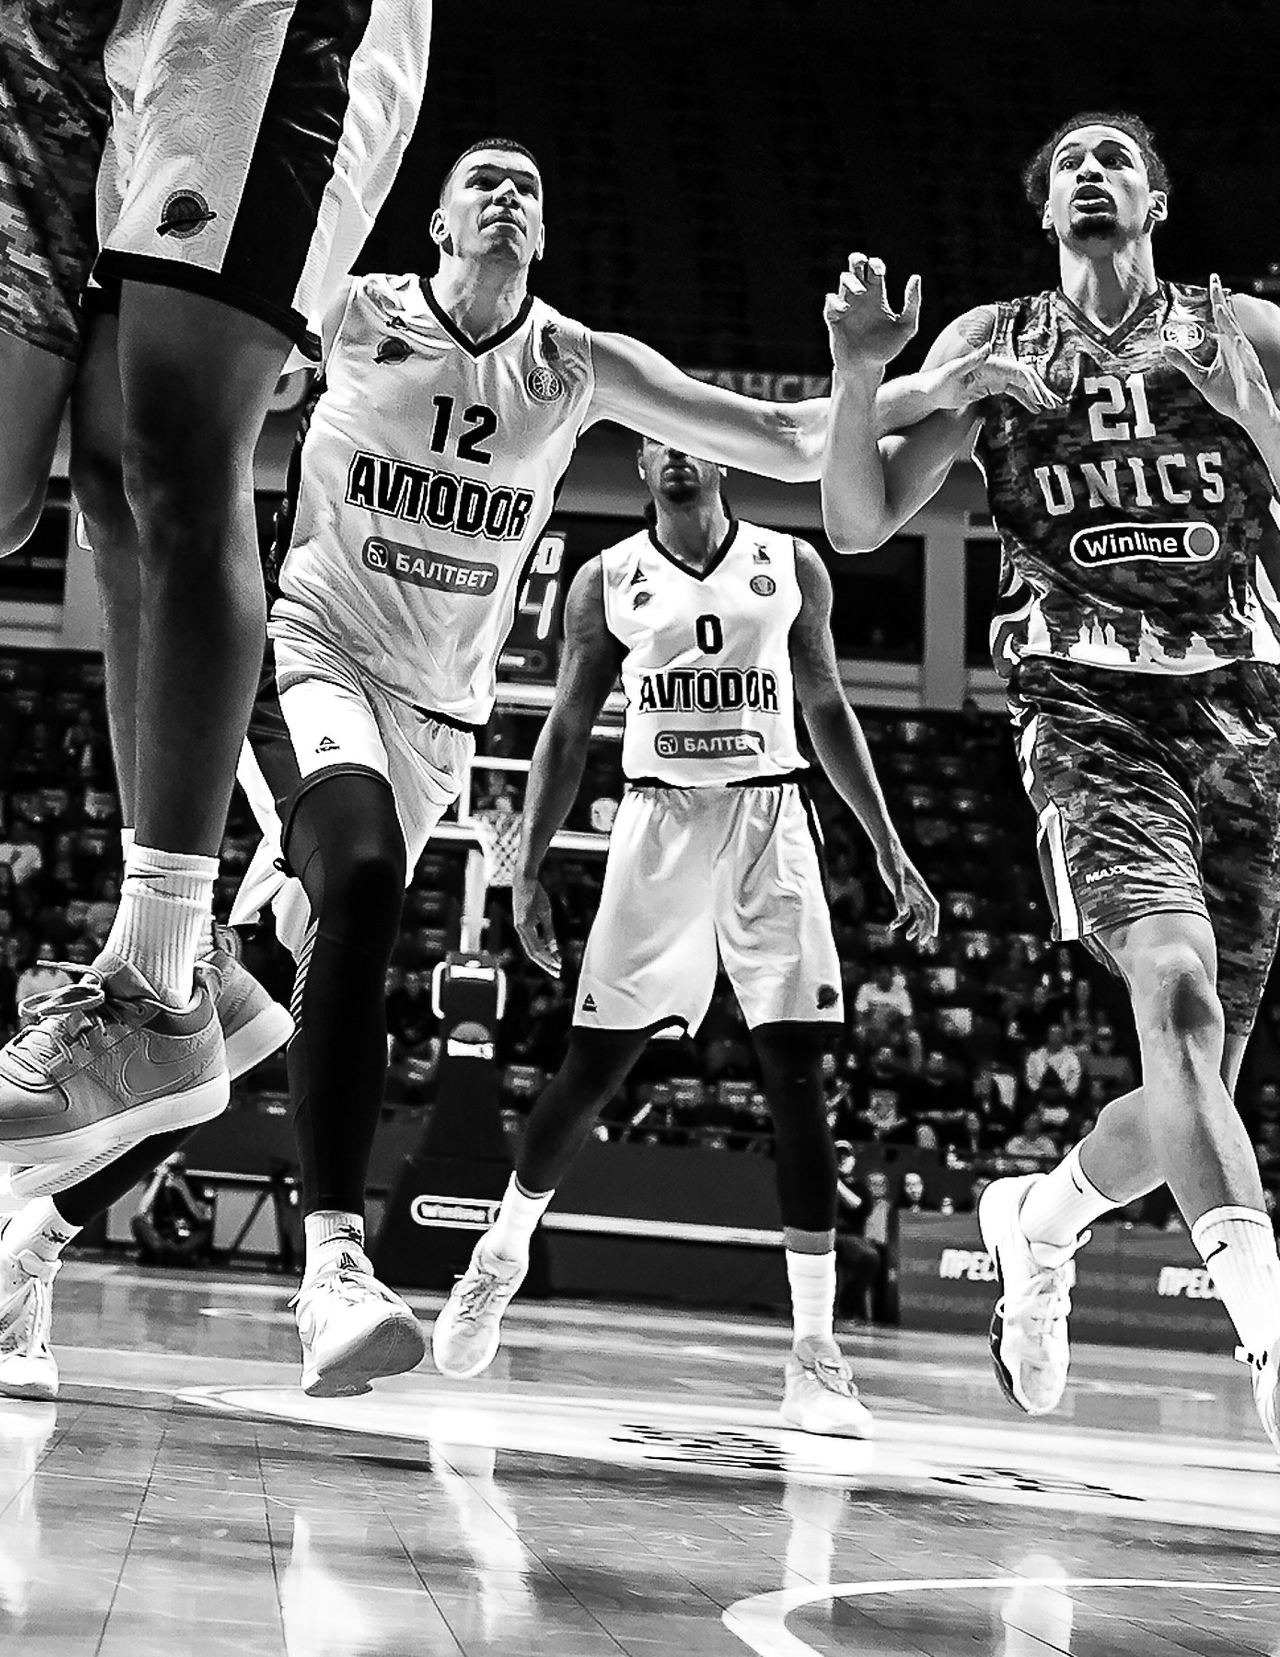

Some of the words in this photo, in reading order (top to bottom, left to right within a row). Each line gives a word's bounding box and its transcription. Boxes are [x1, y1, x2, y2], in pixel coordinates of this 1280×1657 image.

[430, 395, 499, 466] 12
[1083, 372, 1157, 442] 21
[344, 450, 535, 542] AVTODOR
[1033, 451, 1225, 516] UNICS
[394, 552, 494, 590] БАЛТБЕТ
[1083, 533, 1178, 558] Winline
[695, 613, 724, 656] 0
[638, 666, 781, 715] AVTODOR
